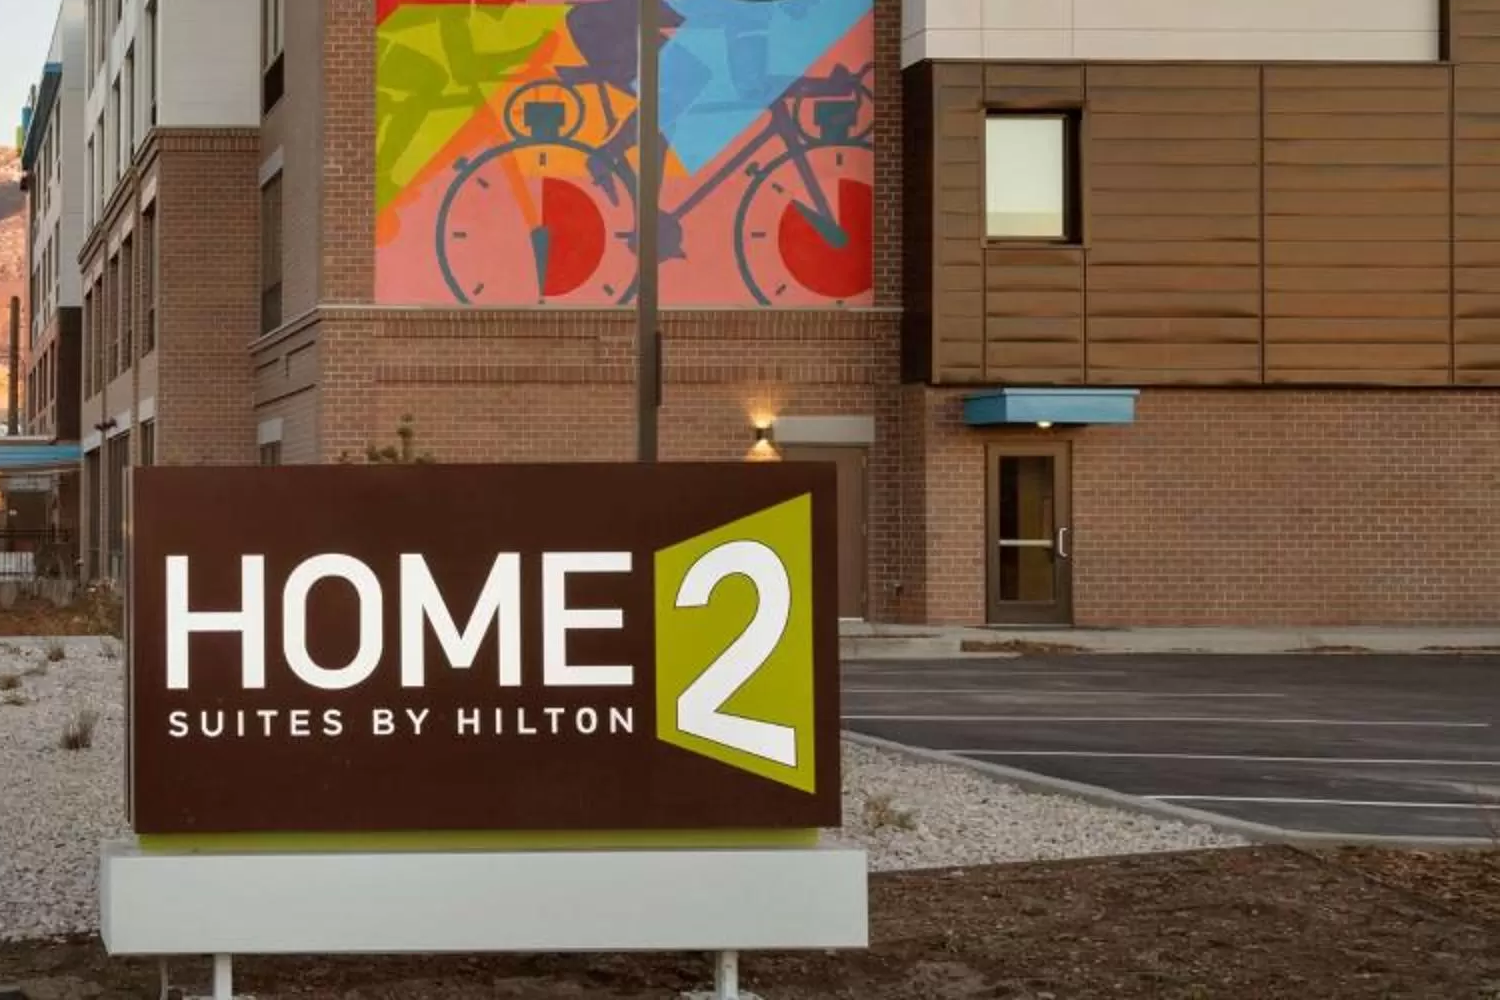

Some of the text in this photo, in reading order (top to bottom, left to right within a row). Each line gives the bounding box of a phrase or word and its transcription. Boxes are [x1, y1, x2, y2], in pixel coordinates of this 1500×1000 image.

[165, 539, 797, 768] HOME 2
[168, 707, 634, 738] SUITES BY HILTON
